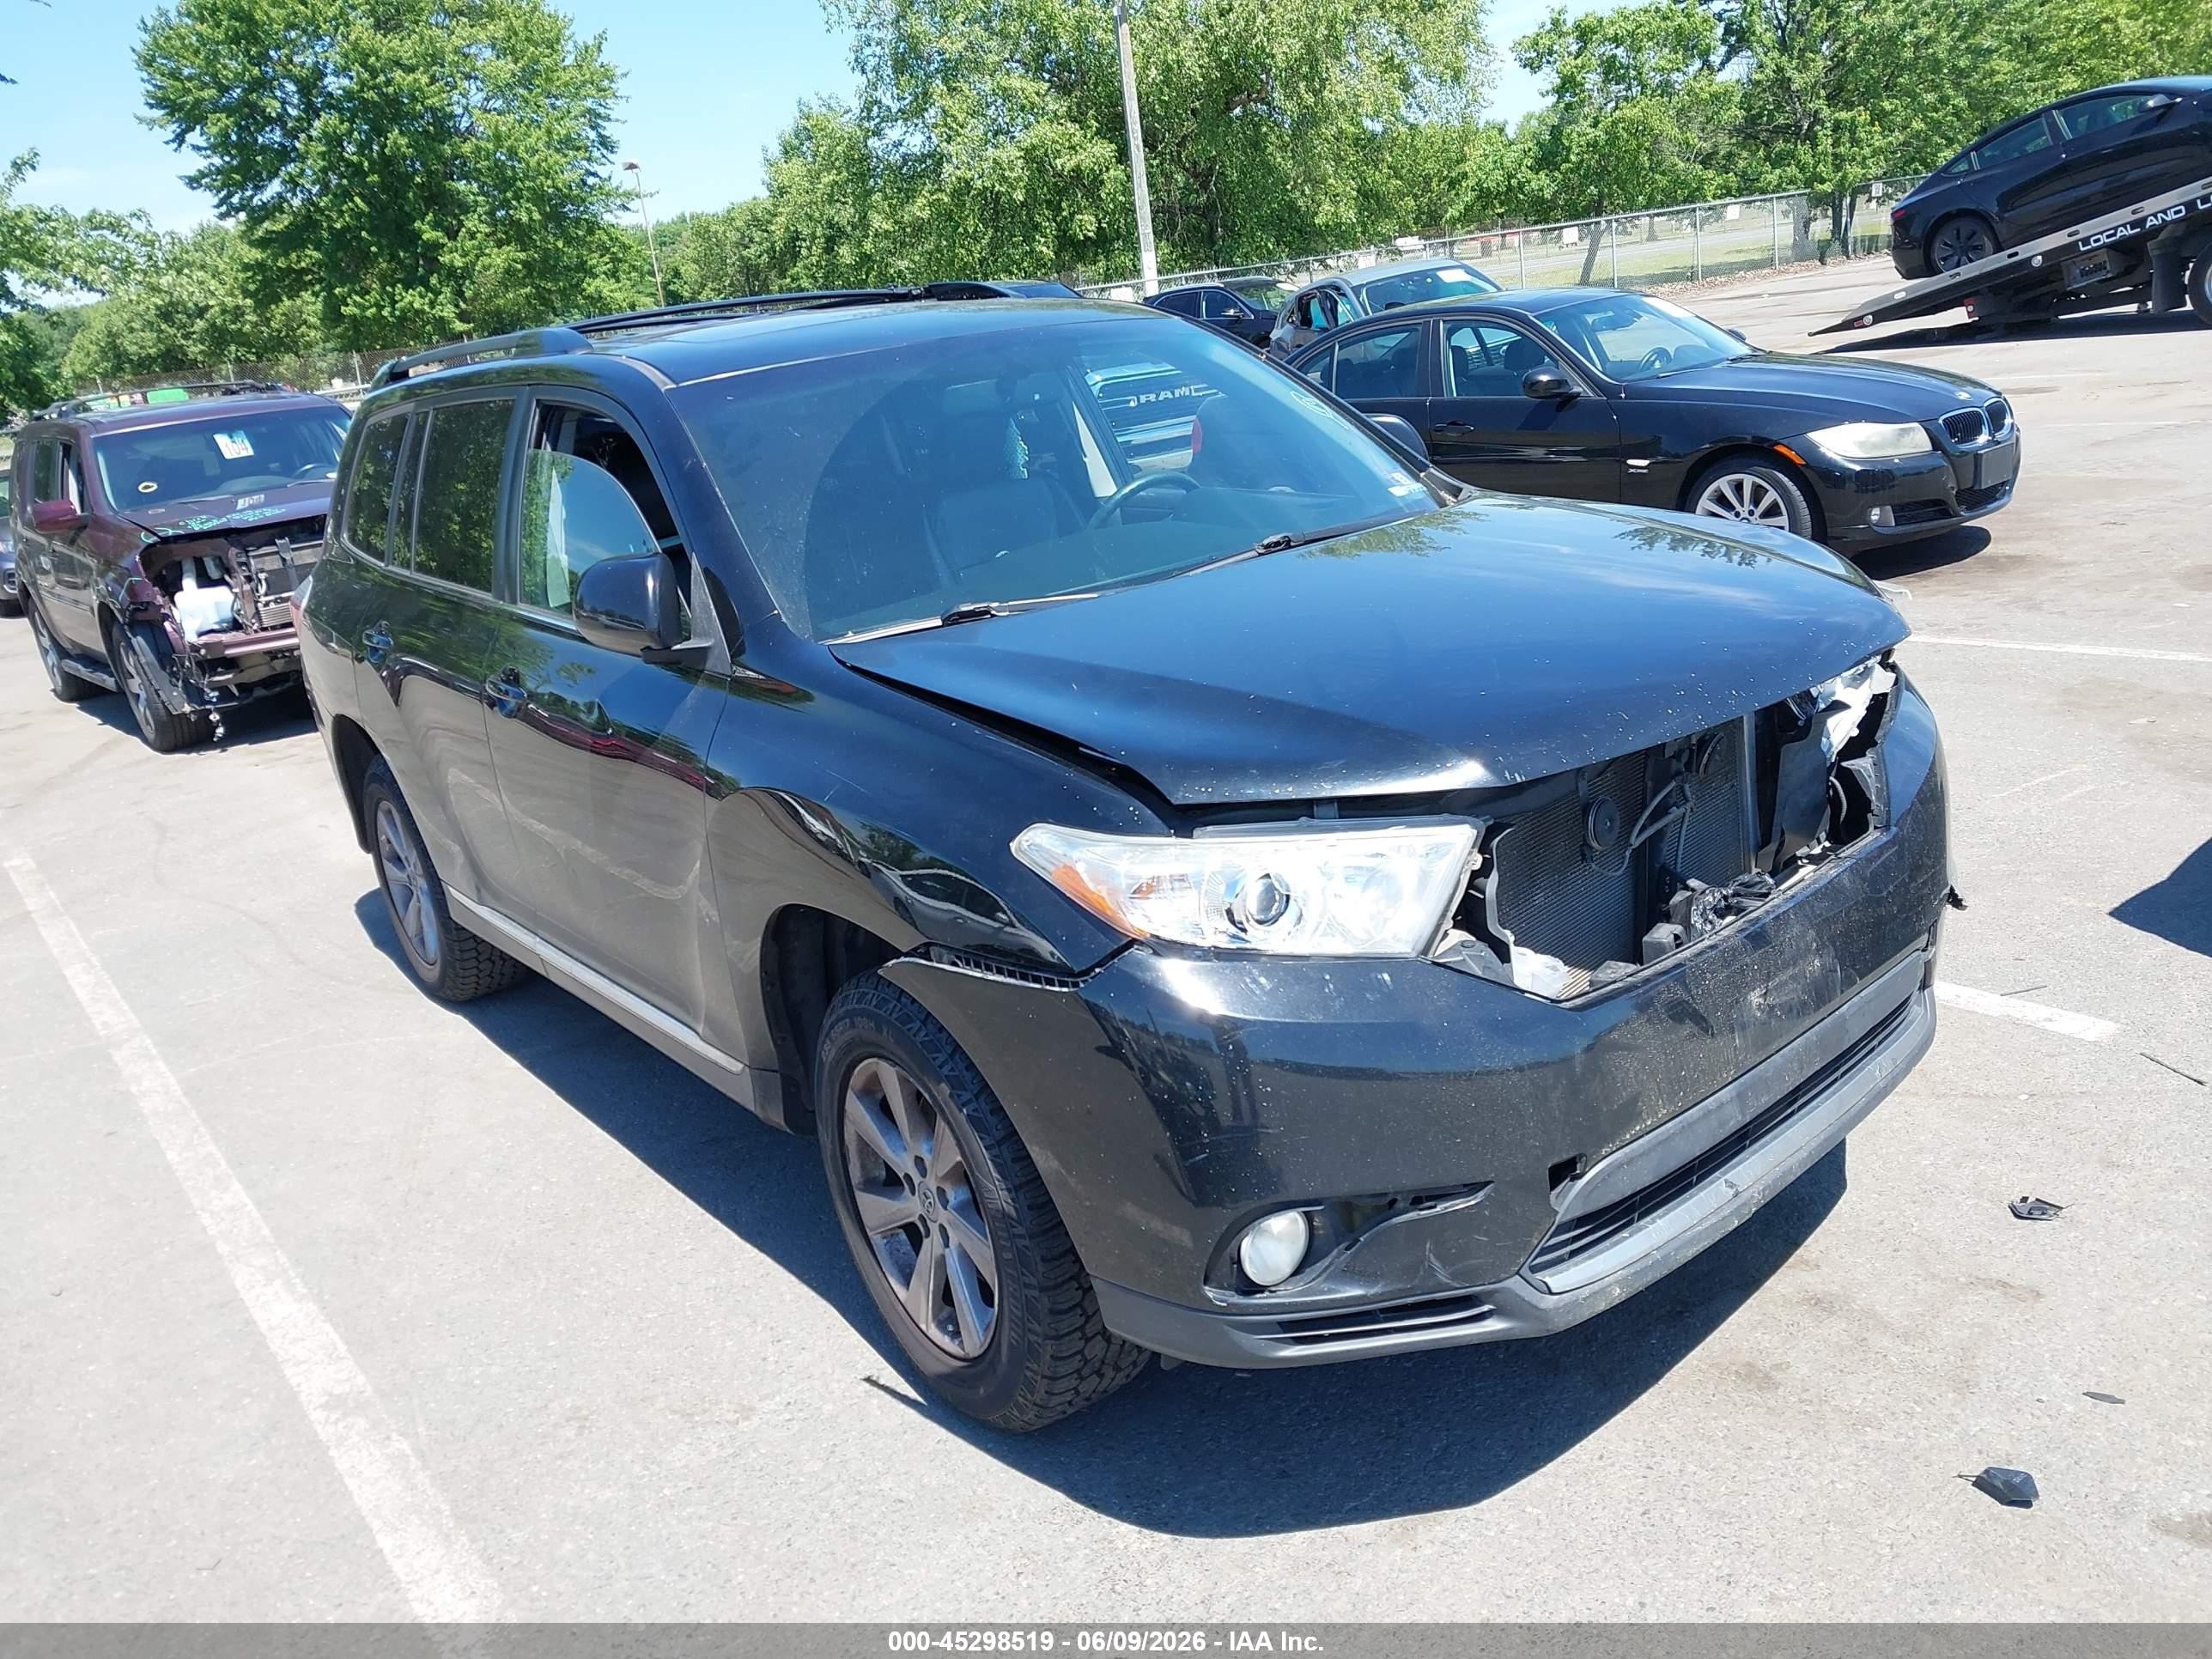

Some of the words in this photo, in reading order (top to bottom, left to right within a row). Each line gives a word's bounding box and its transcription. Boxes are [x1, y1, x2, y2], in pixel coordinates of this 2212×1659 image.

[2078, 224, 2141, 252] LOCAL
[2146, 205, 2186, 229] AND
[2197, 195, 2212, 210] L
[1139, 386, 1191, 404] RAM
